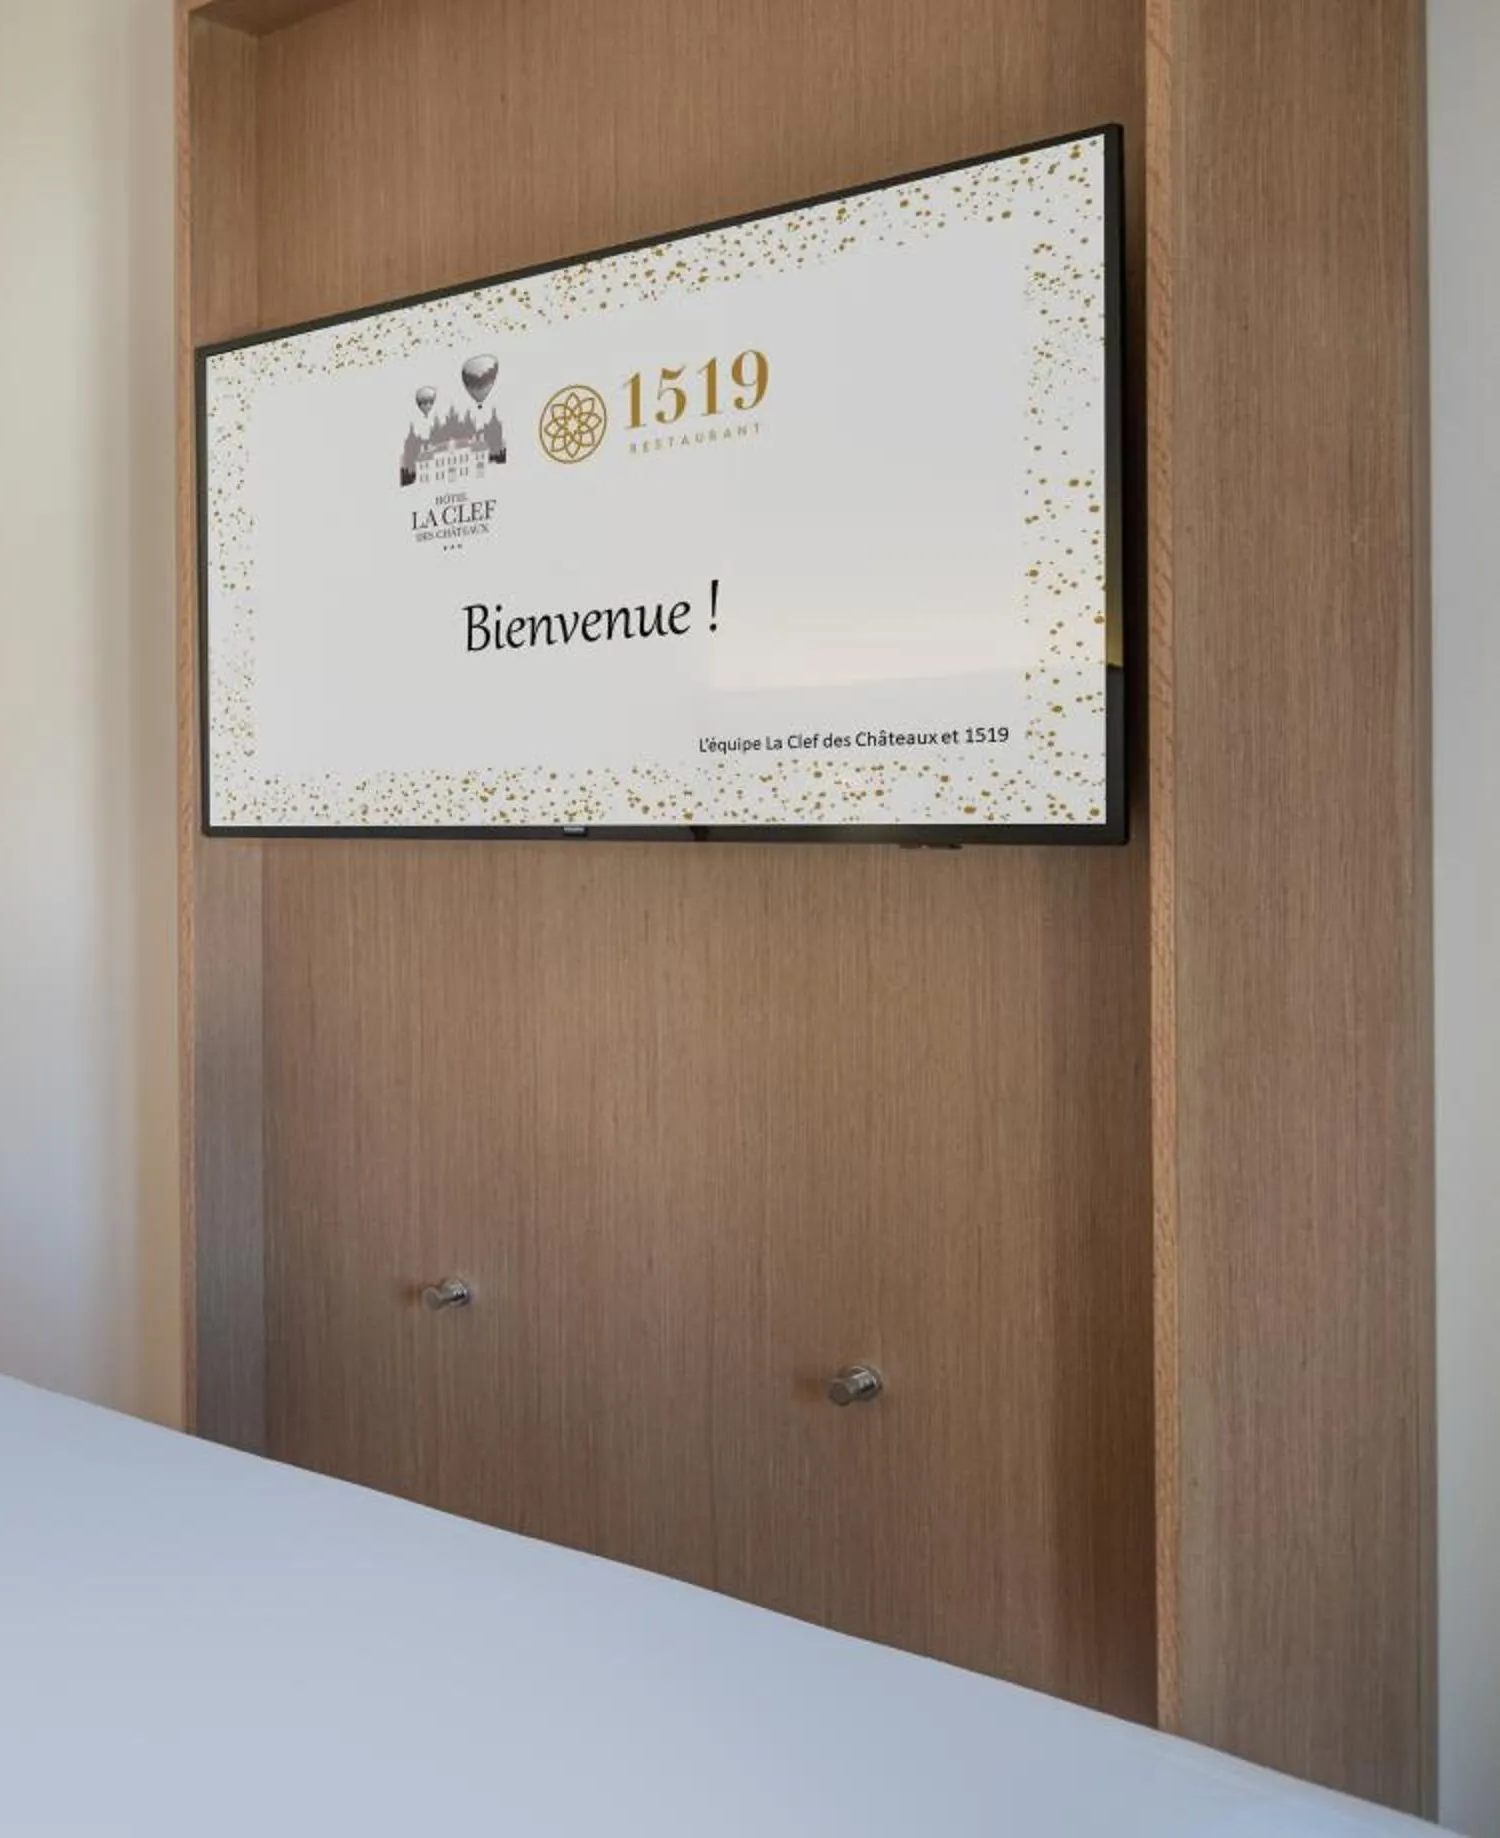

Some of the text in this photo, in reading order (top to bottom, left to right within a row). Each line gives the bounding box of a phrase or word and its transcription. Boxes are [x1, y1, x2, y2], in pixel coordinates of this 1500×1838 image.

[622, 349, 769, 430] 1519
[629, 422, 760, 455] RESTAURANT
[412, 499, 497, 530] LA CLEF
[461, 579, 719, 652] Bienvenue !
[699, 727, 1009, 755] L'équipe La Clef des Châteaux et 1519
